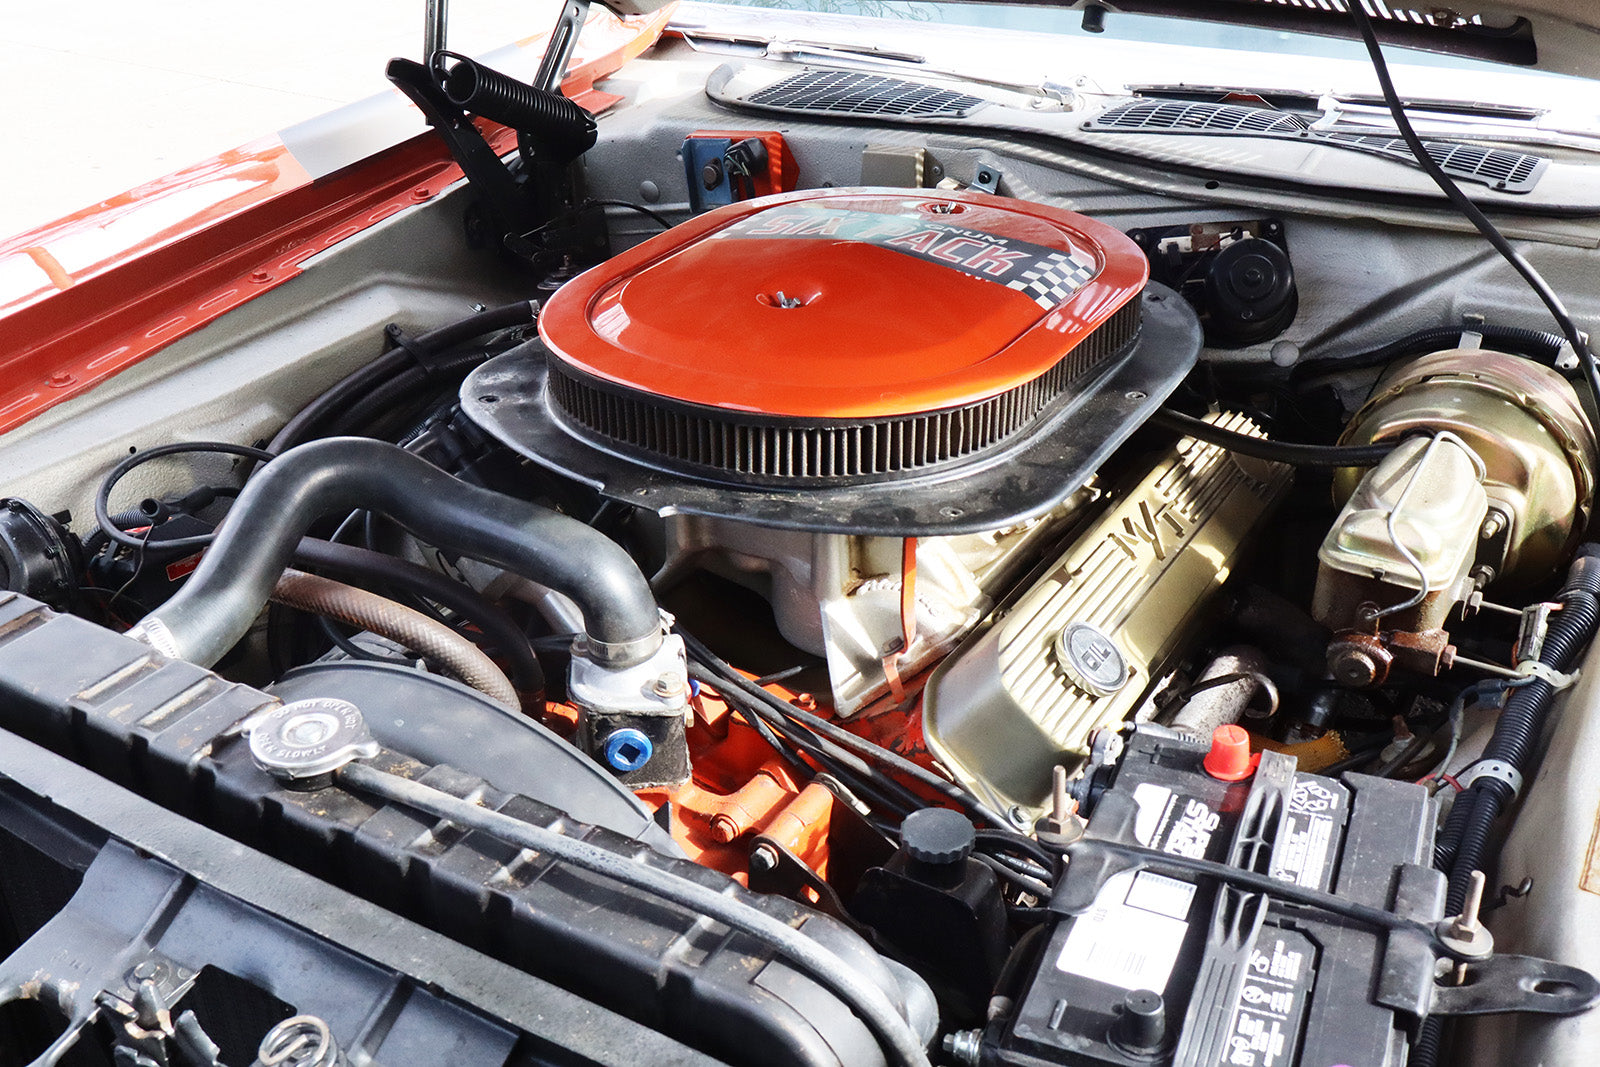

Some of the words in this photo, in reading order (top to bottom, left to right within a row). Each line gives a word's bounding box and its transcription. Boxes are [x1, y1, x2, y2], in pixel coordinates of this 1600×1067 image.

[745, 213, 866, 236] SIX
[853, 221, 1032, 277] PACK
[924, 224, 1009, 245] GNUM
[1081, 641, 1111, 671] OIL
[294, 701, 318, 710] NOT
[276, 745, 325, 758] SLOWLY
